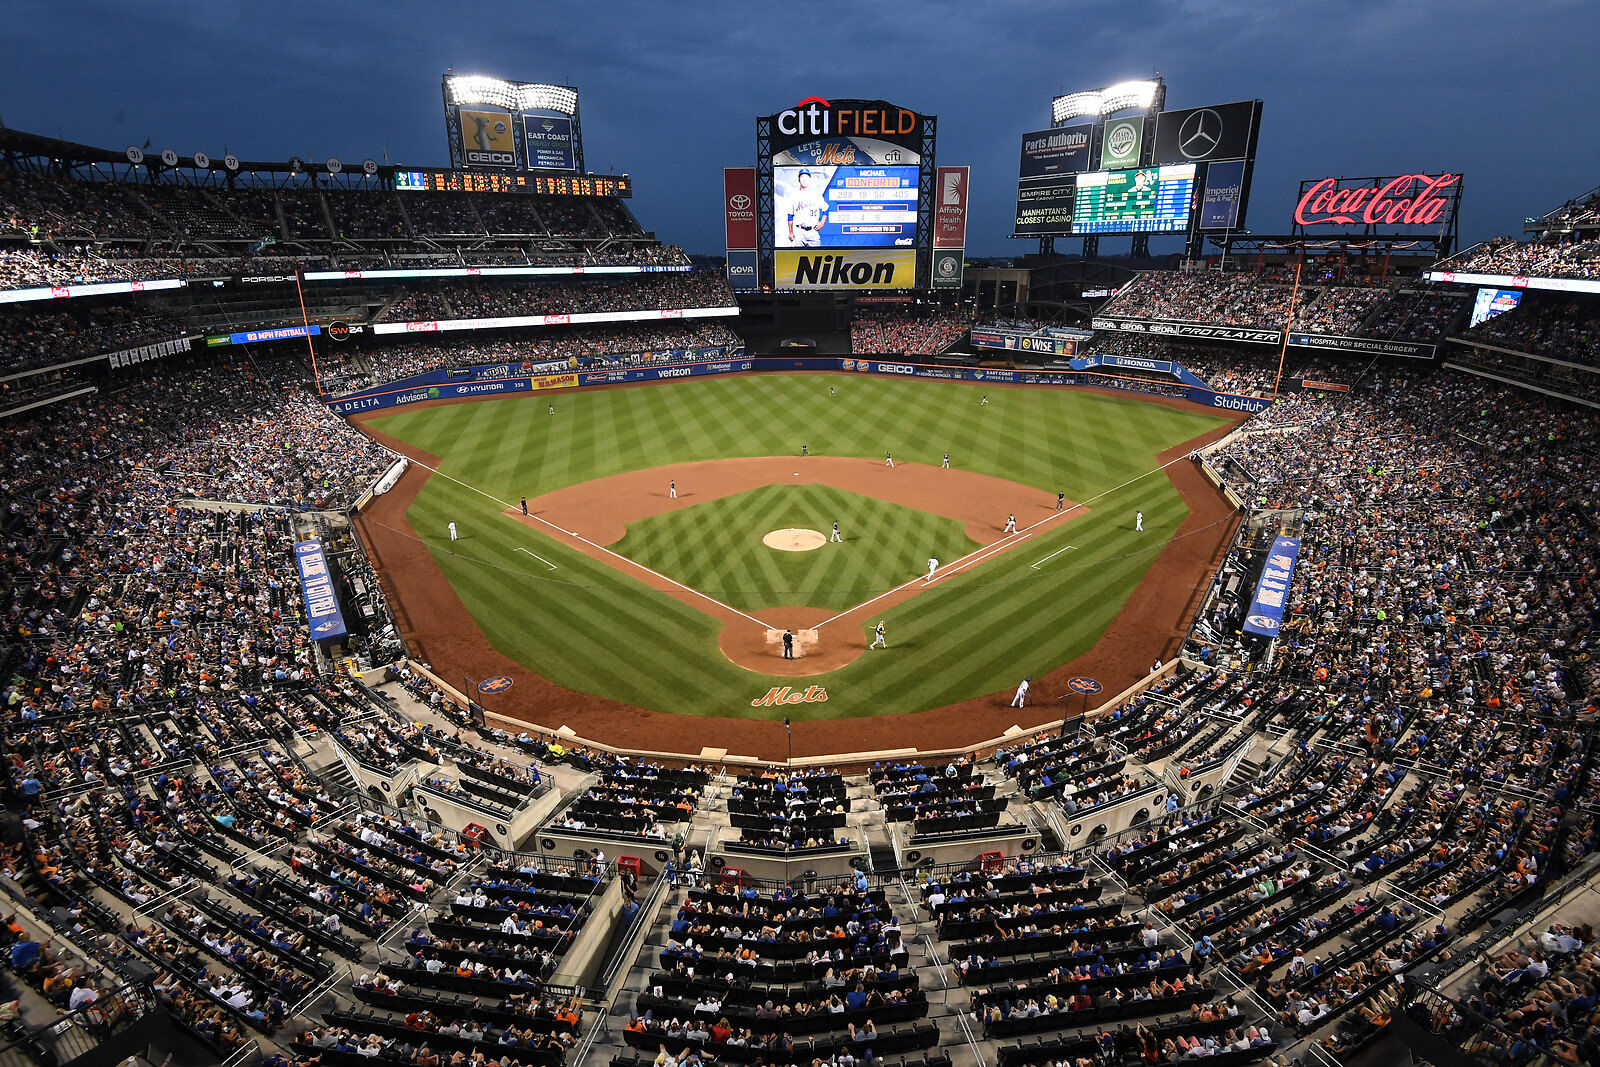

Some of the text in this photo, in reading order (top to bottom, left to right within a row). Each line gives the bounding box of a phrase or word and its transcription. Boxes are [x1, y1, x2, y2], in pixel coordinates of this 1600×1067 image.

[778, 103, 916, 134] citi FIELD
[798, 141, 820, 152] LET'S
[1026, 132, 1087, 150] Parts Authority
[131, 150, 140, 158] 31
[165, 153, 174, 161] 41
[198, 155, 206, 163] 14
[468, 151, 513, 164] GEICO
[810, 143, 857, 164] GO Mets
[884, 150, 901, 161] citi
[847, 178, 898, 187] CONFORTO
[1206, 186, 1239, 195] Imperial
[1295, 173, 1461, 225] Coca-Cola
[939, 206, 964, 215] Affinity
[1022, 207, 1066, 216] MANHATTAN'S
[1017, 215, 1071, 224] CLOSEST CASINO
[794, 255, 896, 285] Nikon
[258, 331, 274, 339] MPH
[275, 328, 306, 337] FASTBALL
[1149, 325, 1173, 333] SPDR
[1180, 327, 1279, 342] PRO PLAYER
[1032, 339, 1052, 351] WISE
[1310, 338, 1338, 346] HOSPITAL
[1384, 345, 1418, 353] SURGERY
[658, 367, 691, 378] verizon
[878, 364, 913, 374] GEICO
[396, 393, 428, 404] Advisors
[1214, 396, 1263, 412] StubHub
[345, 398, 379, 411] DELTA
[751, 685, 828, 707] Mets
